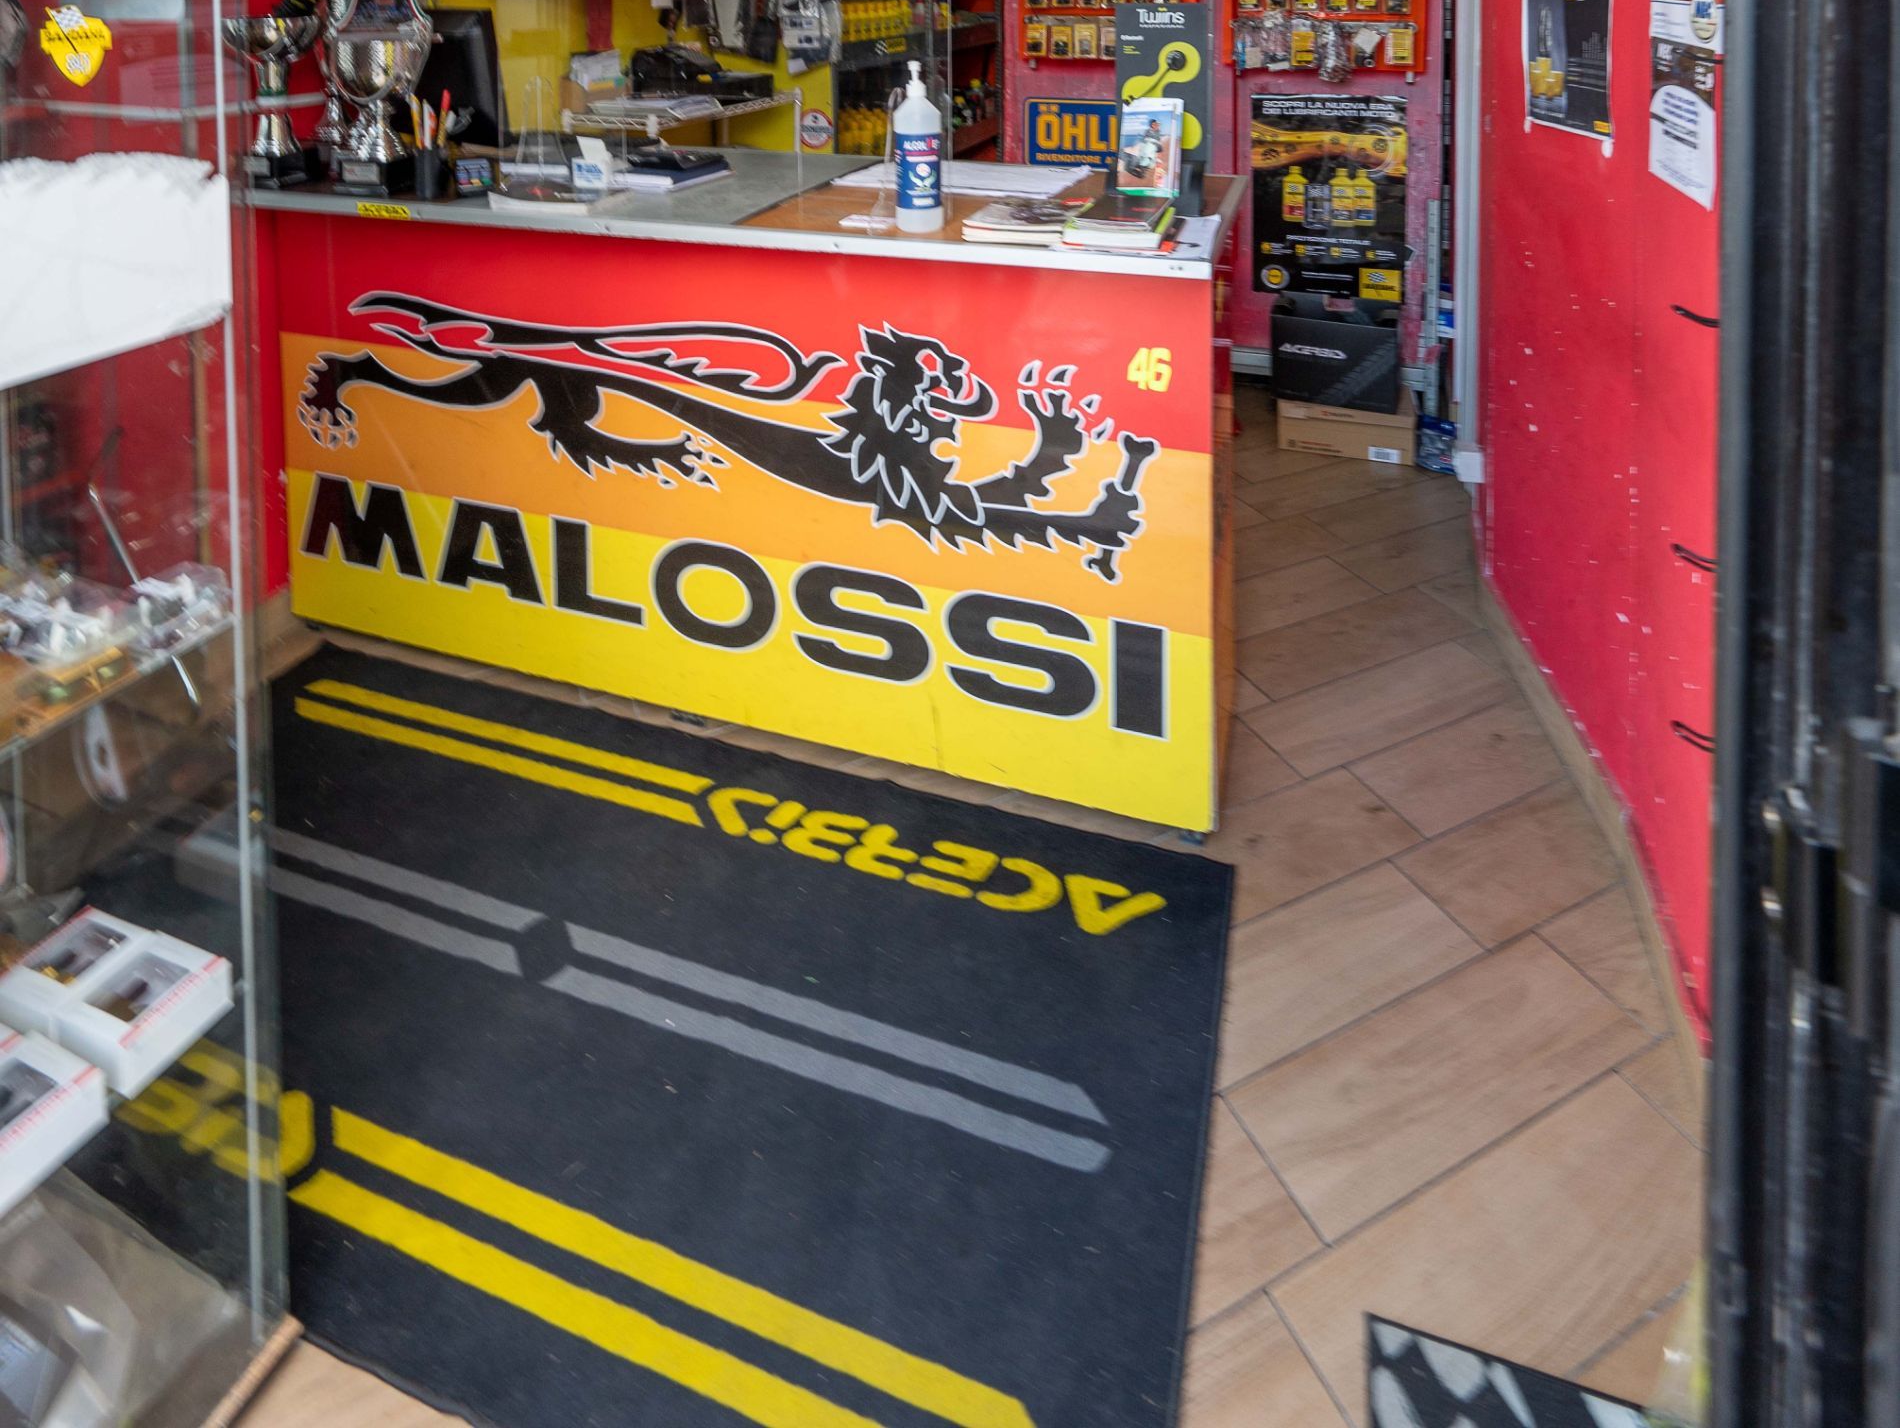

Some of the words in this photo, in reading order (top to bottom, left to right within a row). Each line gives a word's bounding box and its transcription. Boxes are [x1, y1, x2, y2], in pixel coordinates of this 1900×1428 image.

[1262, 100, 1306, 108] SCOPRI
[1307, 101, 1323, 109] LA
[1325, 102, 1367, 110] NUOVA
[1369, 103, 1395, 111] ERA
[1283, 108, 1358, 116] LUBRIFICANTI
[1360, 110, 1396, 118] MOTO
[1036, 104, 1118, 153] ÖHLI
[1035, 152, 1101, 164] RIVENDITORE
[1126, 347, 1173, 393] 46
[299, 472, 1171, 741] MALOSSI
